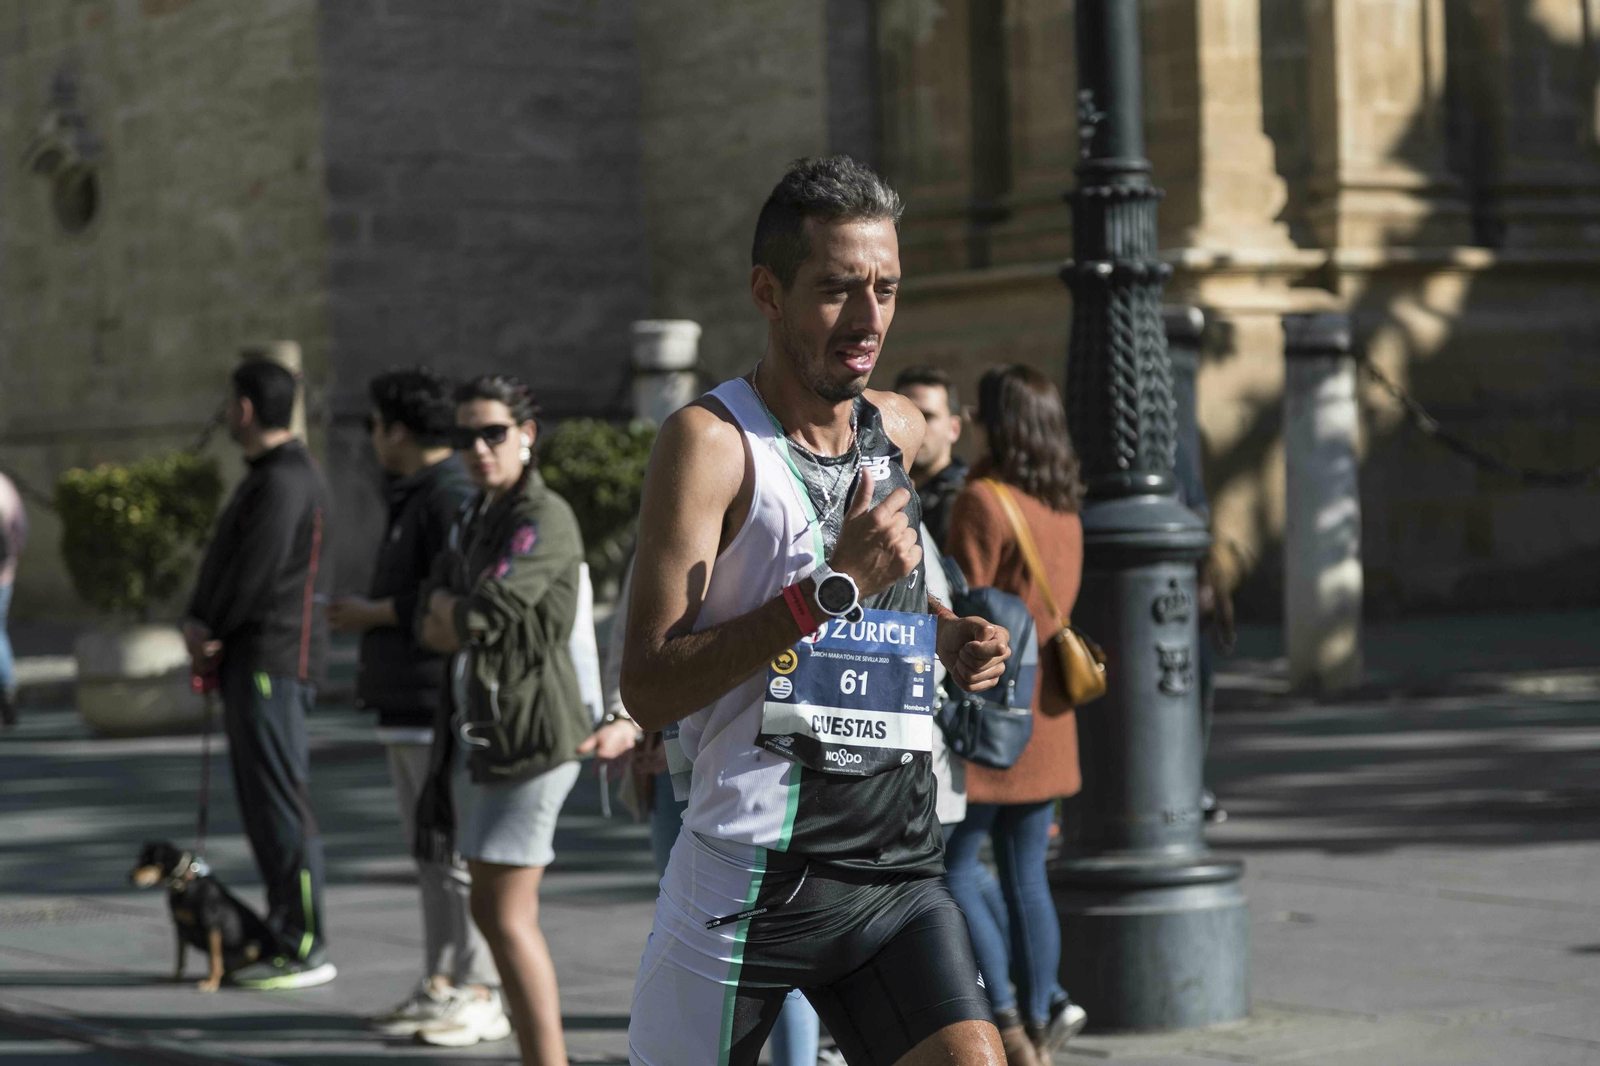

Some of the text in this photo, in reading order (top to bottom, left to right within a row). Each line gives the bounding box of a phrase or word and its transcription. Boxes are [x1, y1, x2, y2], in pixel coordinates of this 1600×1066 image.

[831, 618, 916, 646] ZURICH
[839, 669, 869, 696] 61
[811, 714, 887, 740] CUESTAS
